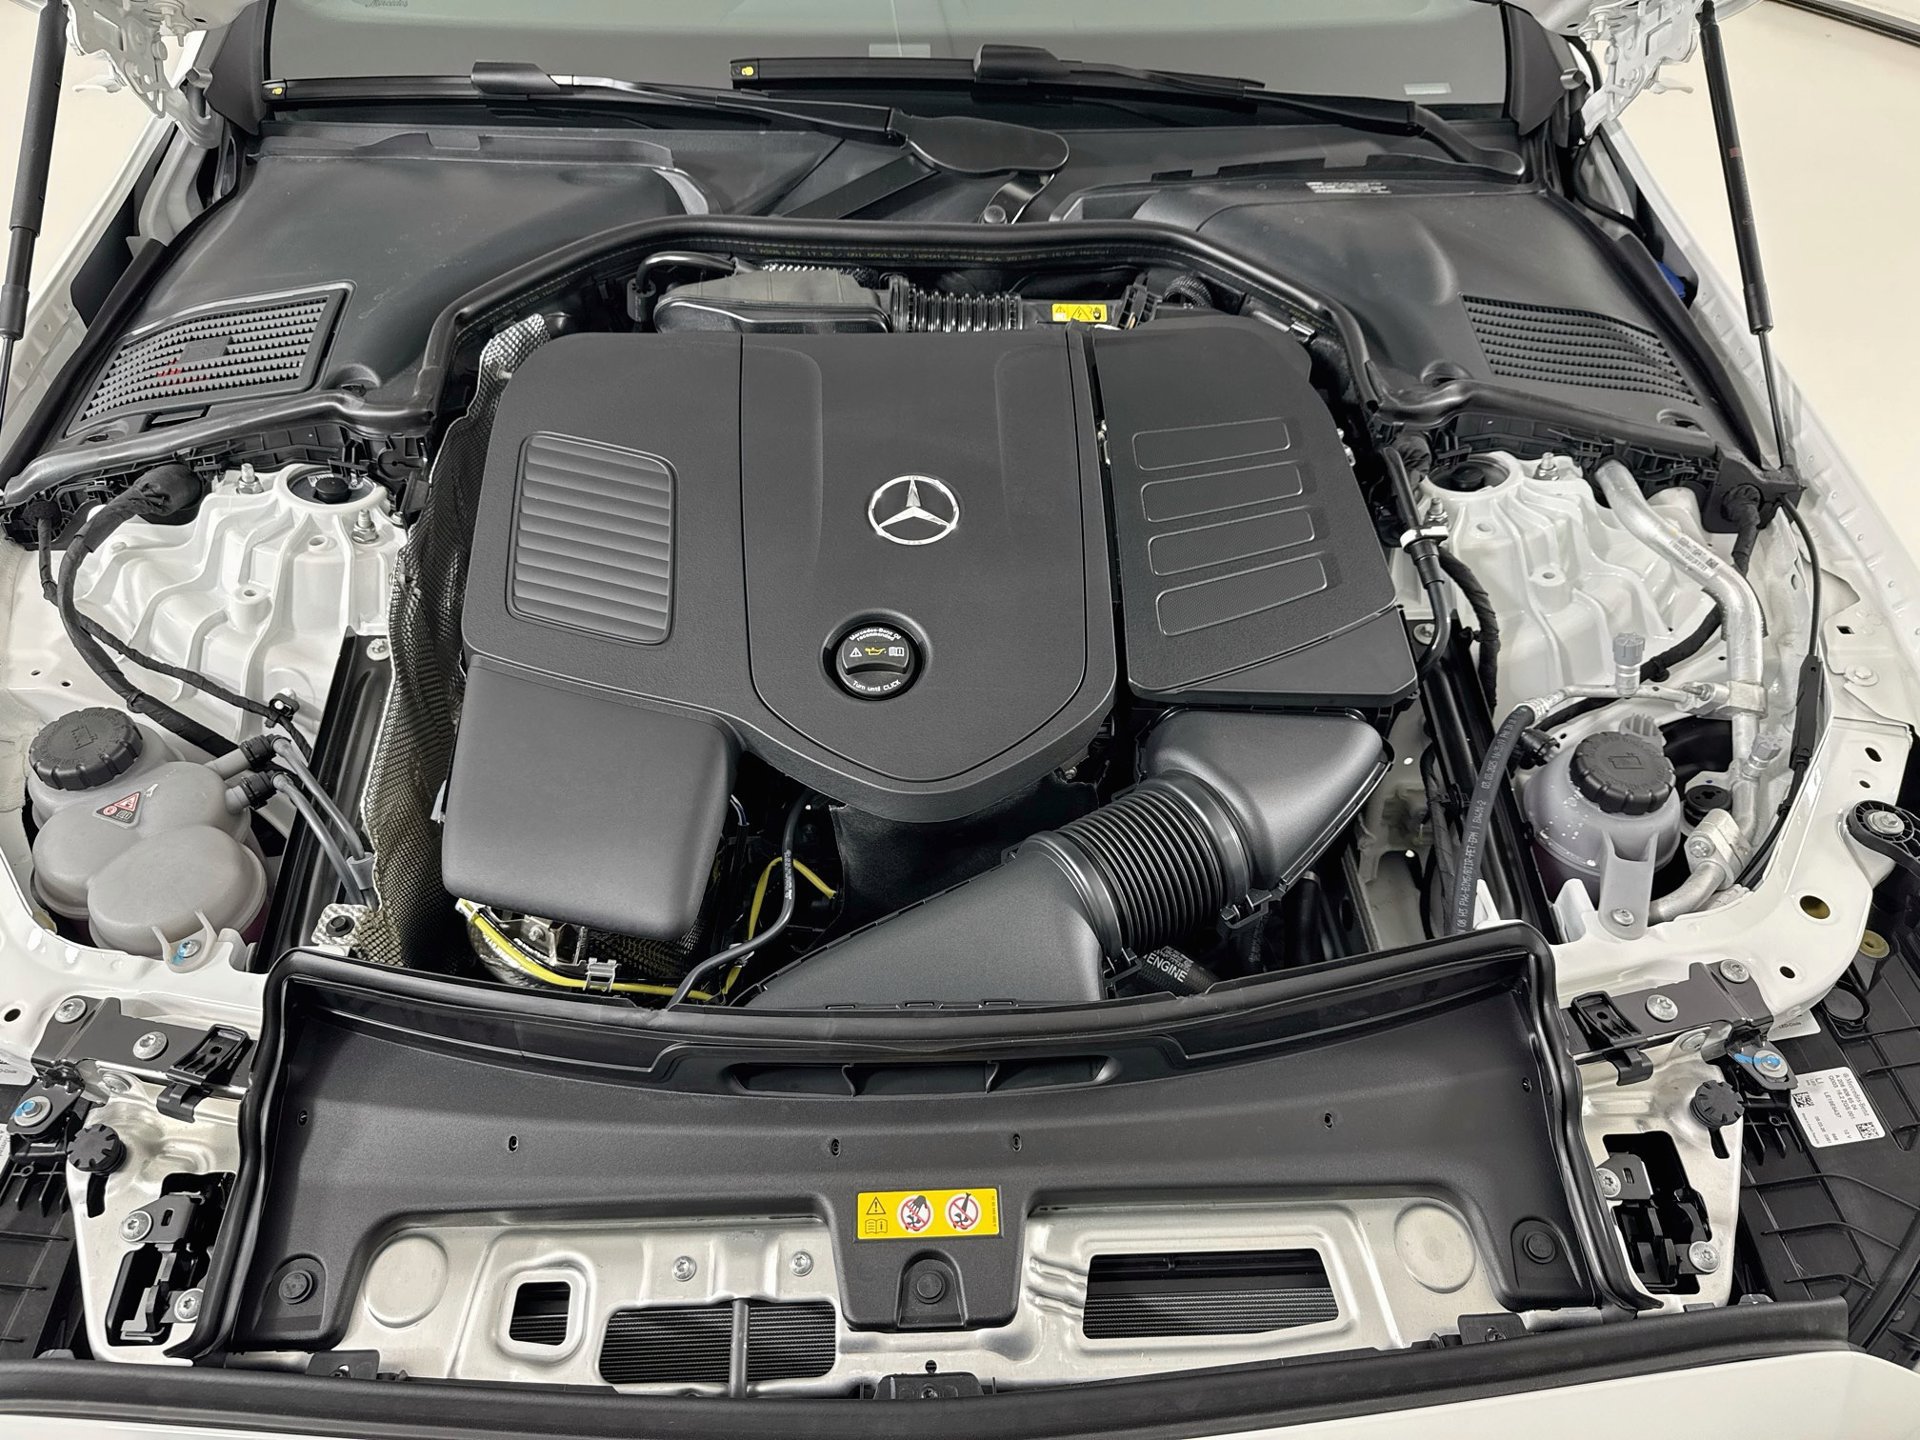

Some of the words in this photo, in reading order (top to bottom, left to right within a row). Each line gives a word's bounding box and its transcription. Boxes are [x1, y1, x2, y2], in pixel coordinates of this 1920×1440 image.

[849, 627, 892, 640] Mercedes-Benz
[856, 632, 895, 641] recommended
[852, 680, 866, 690] Turn
[883, 679, 902, 691] CLICK
[1146, 952, 1188, 983] ENGINE
